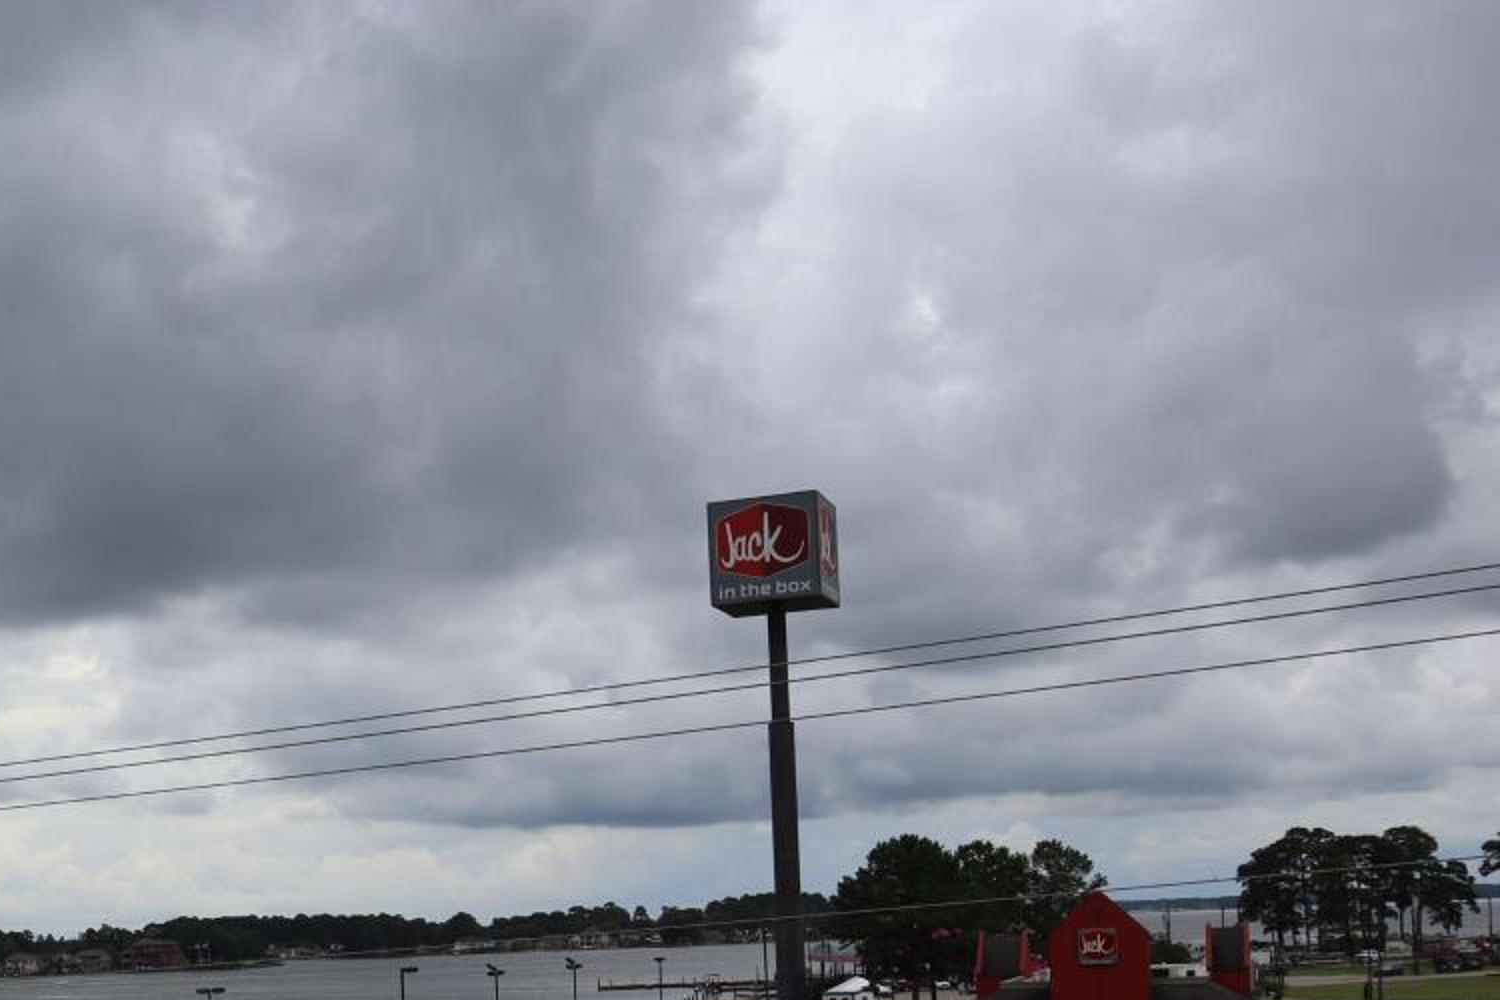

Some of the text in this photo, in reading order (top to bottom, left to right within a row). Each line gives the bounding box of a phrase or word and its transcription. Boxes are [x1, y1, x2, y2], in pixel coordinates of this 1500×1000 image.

[721, 511, 805, 569] Jack
[719, 584, 736, 600] in
[740, 582, 772, 598] the
[775, 580, 812, 593] box
